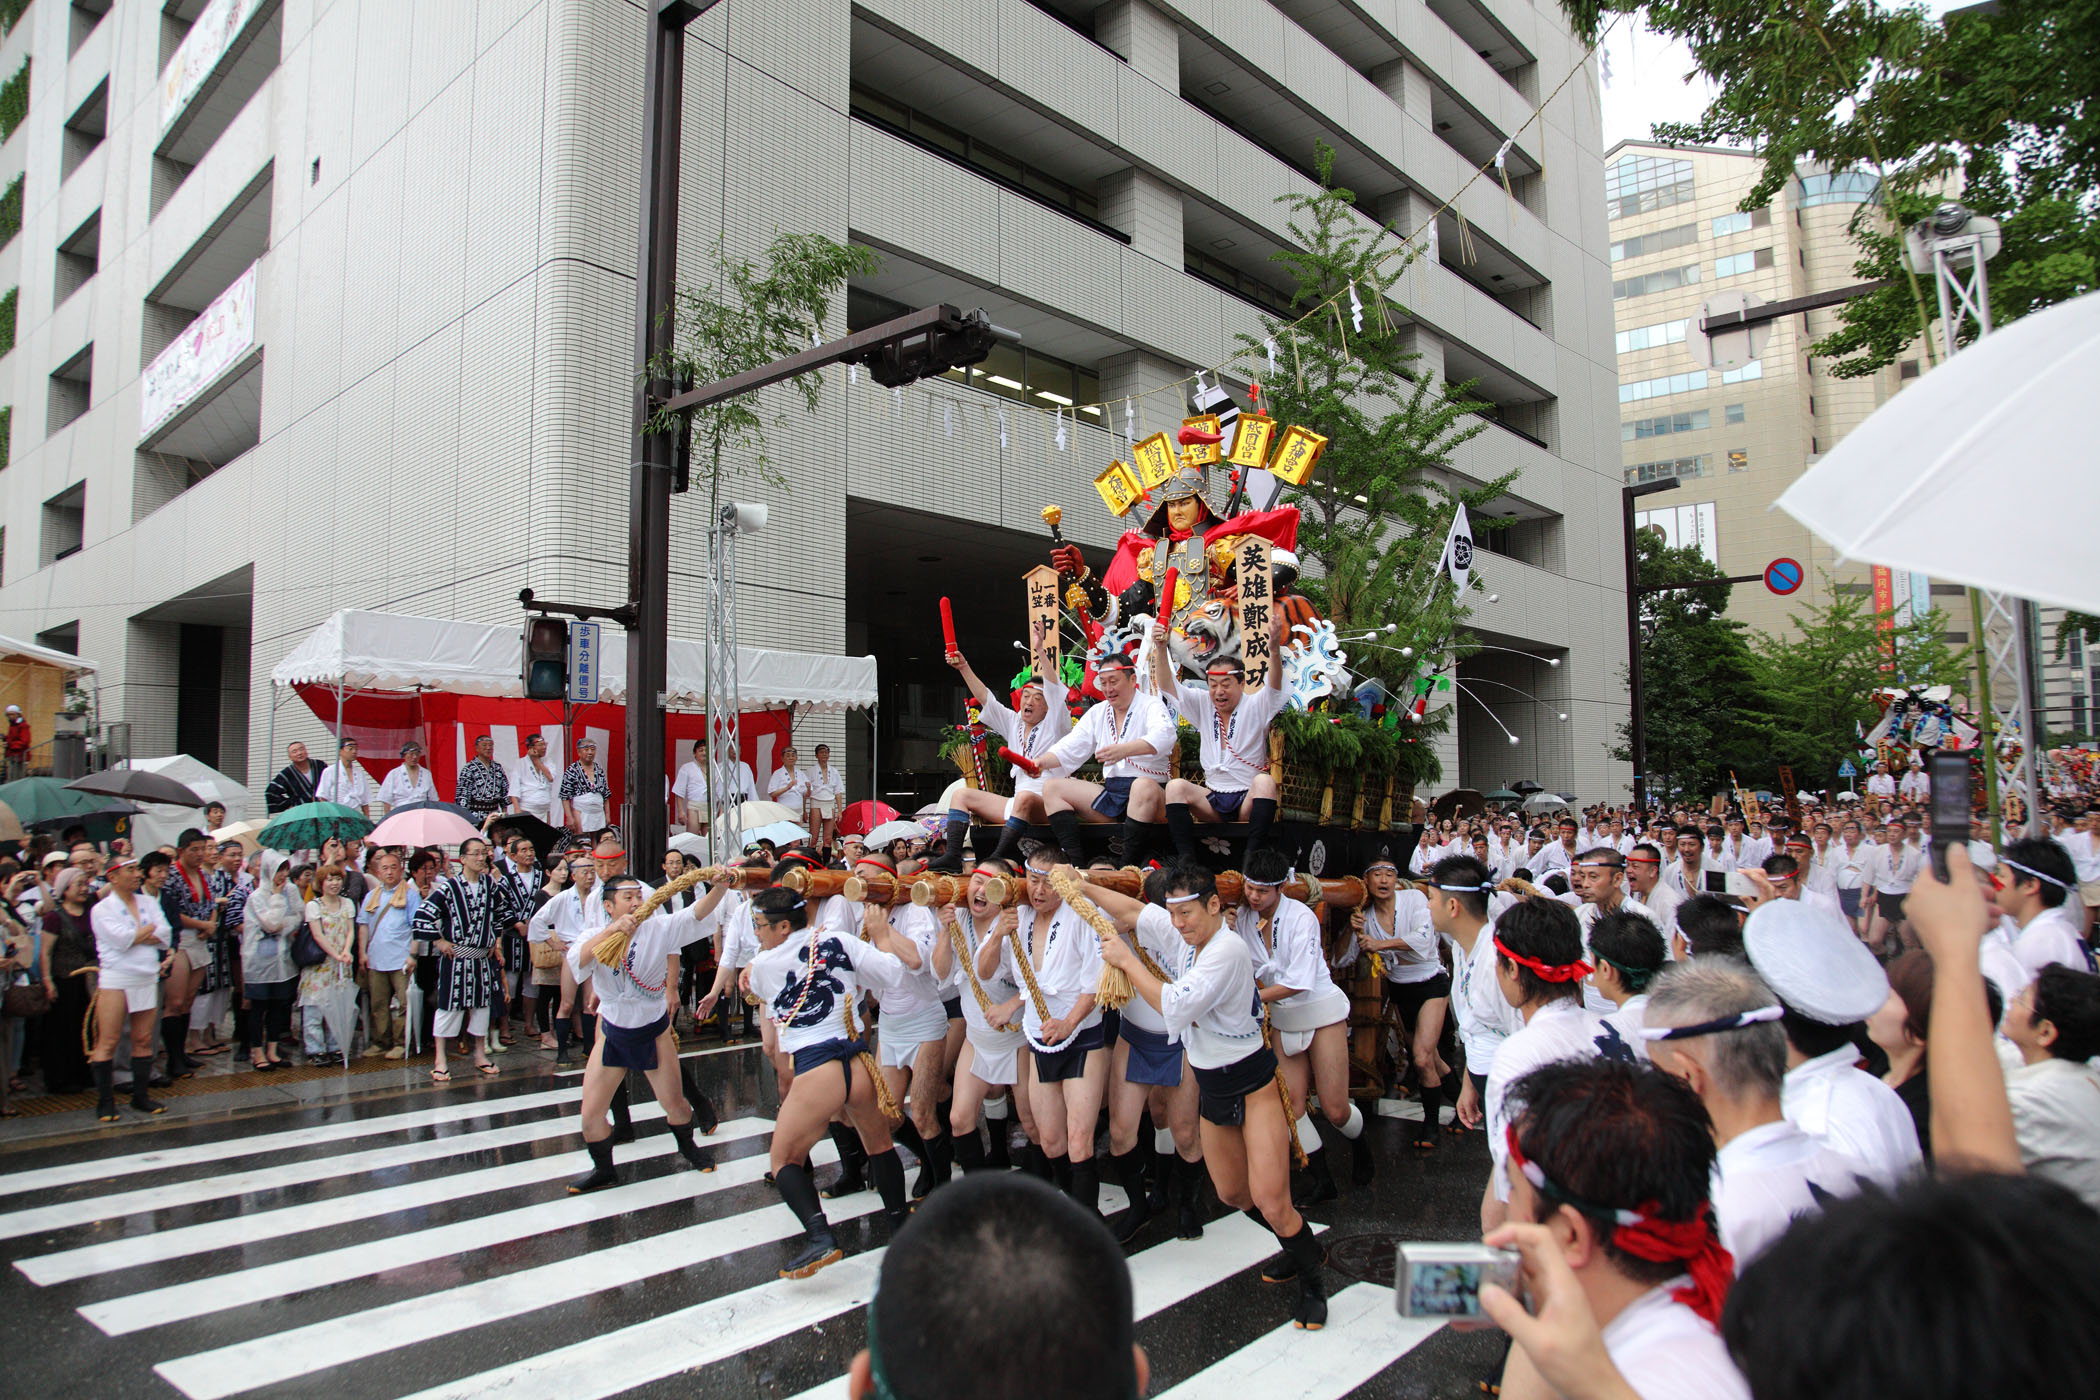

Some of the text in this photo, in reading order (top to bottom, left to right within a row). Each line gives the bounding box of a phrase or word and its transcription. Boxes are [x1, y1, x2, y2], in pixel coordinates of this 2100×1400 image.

[1030, 581, 1044, 609] 山笠
[1043, 584, 1058, 608] 一番
[1241, 543, 1270, 688] 英雄鄭成功
[578, 625, 591, 699] 歩車分離信号
